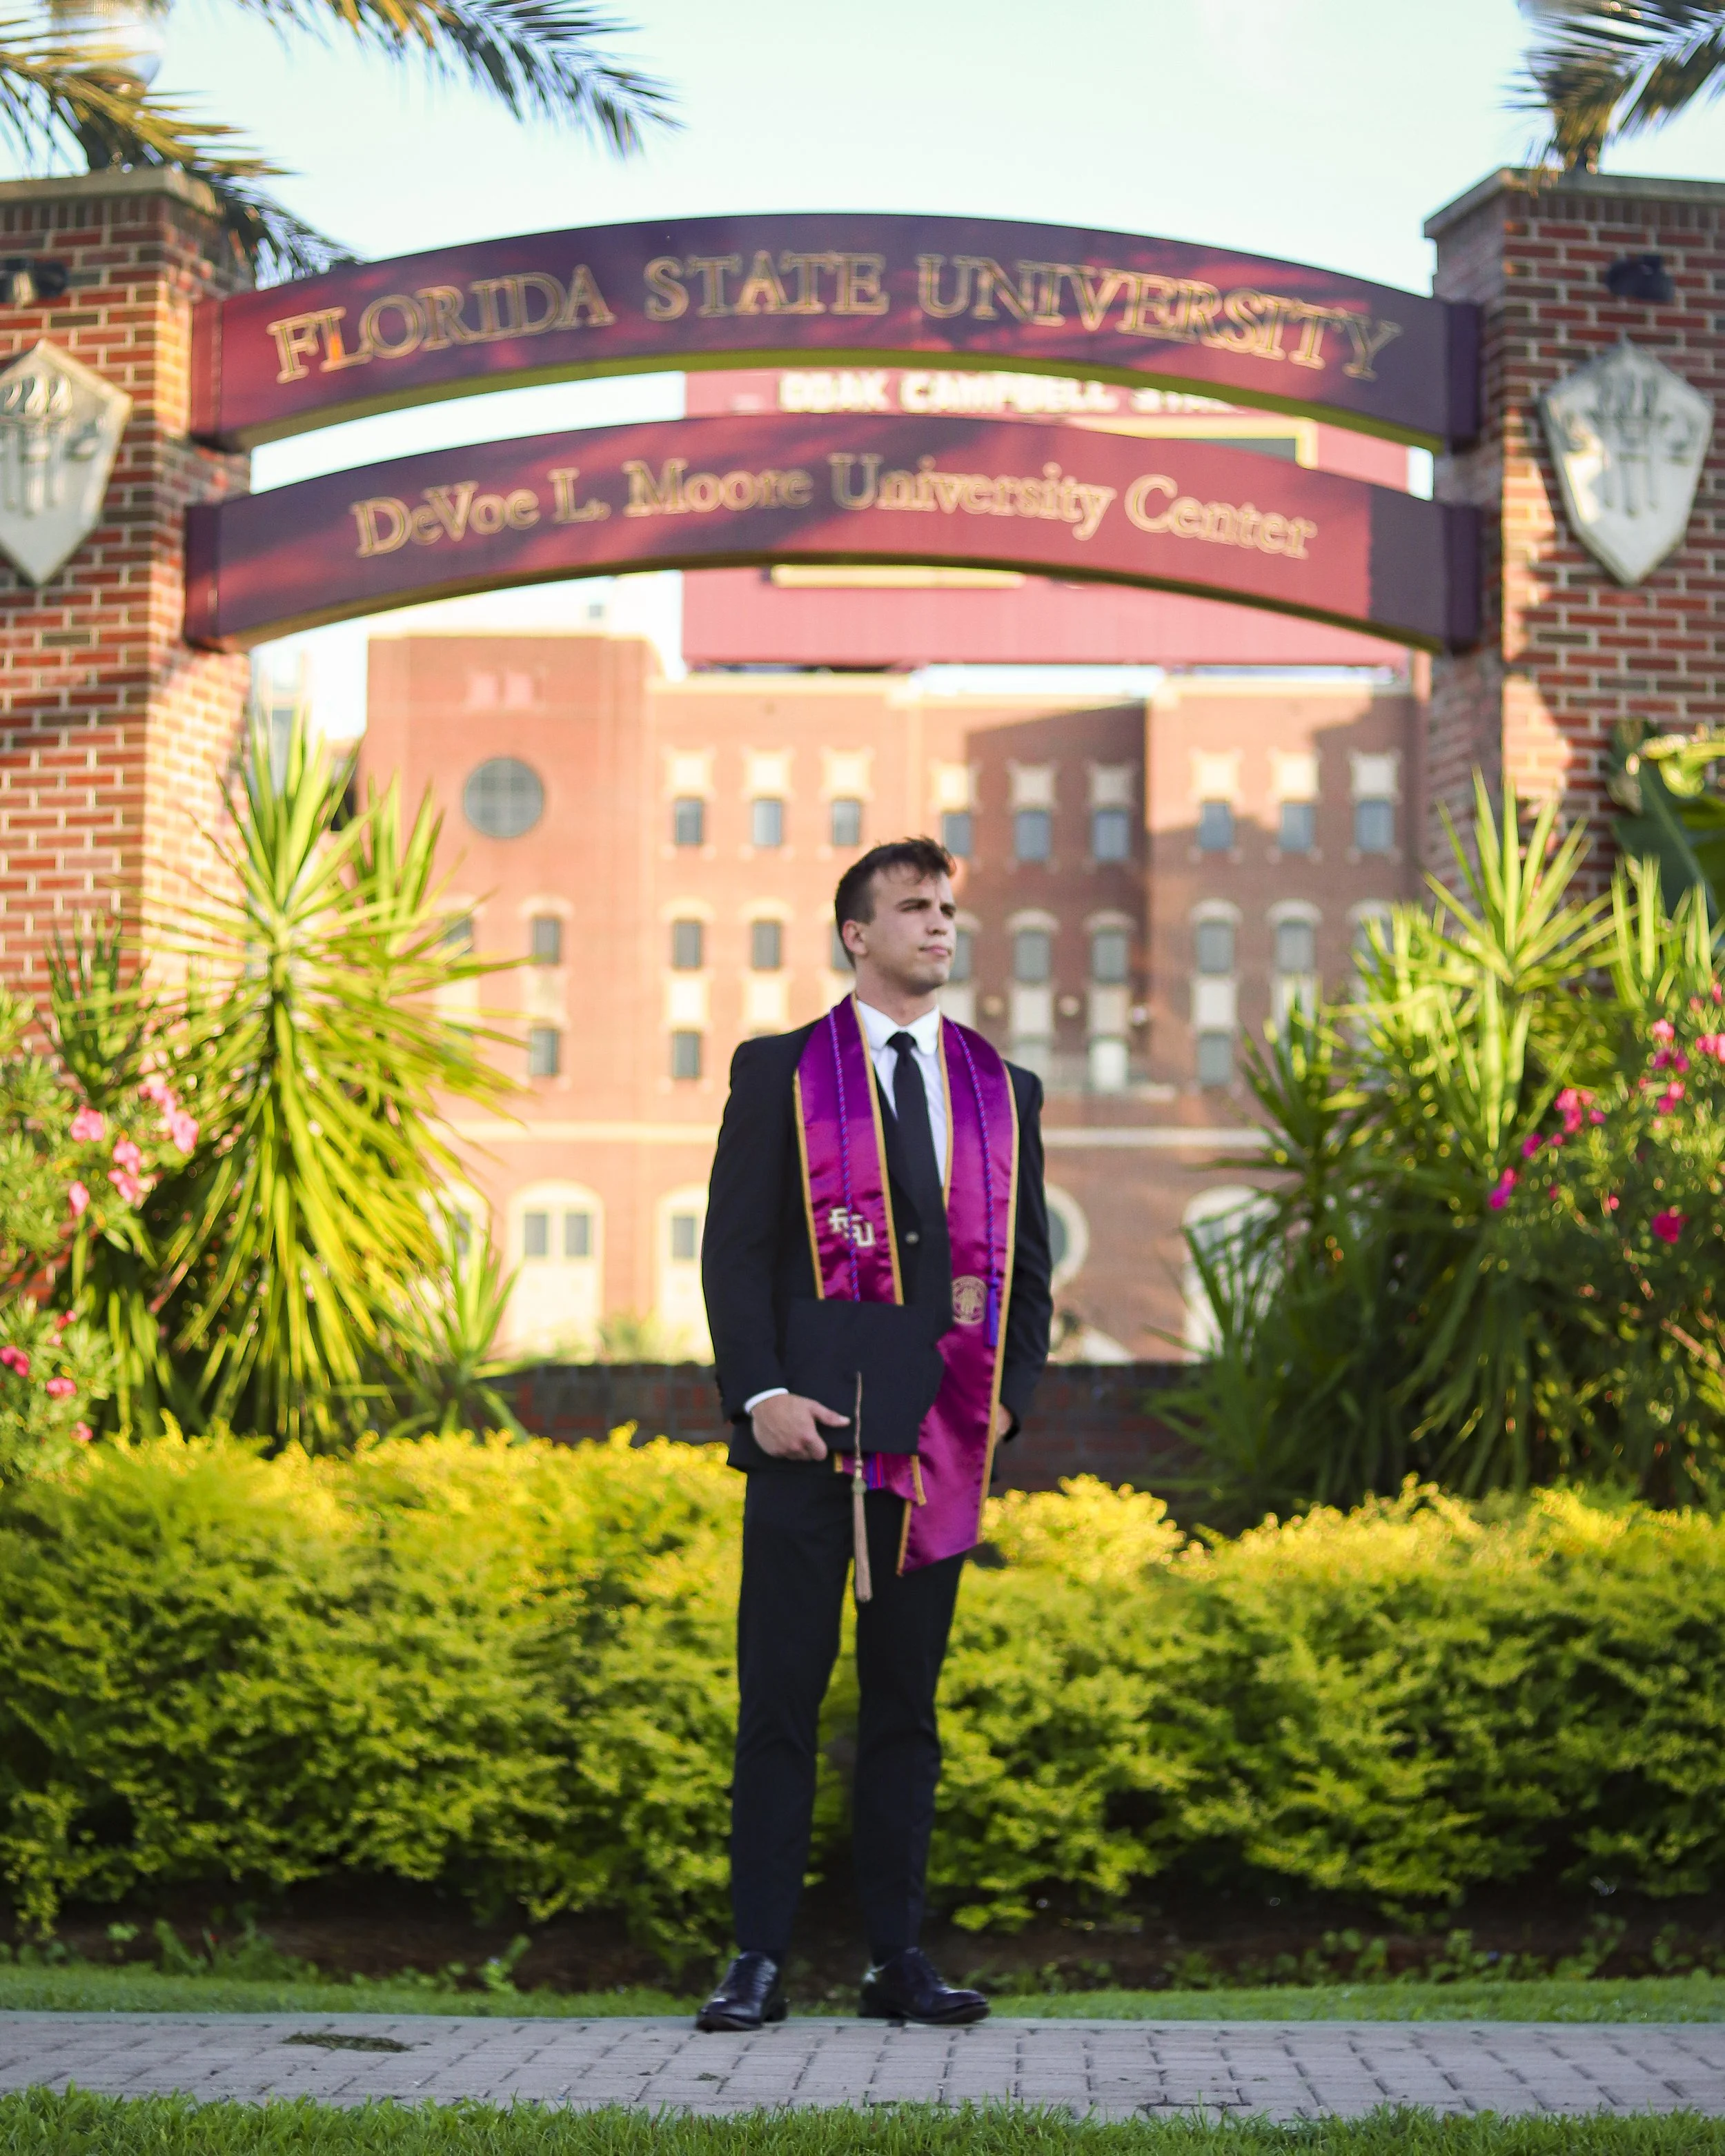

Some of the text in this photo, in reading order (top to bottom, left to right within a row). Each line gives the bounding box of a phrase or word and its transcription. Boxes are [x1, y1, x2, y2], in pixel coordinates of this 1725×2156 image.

[266, 249, 1403, 384] FLORIDA STATE UNIVERSITY
[349, 452, 1319, 560] DeVoe L. Moore University Center
